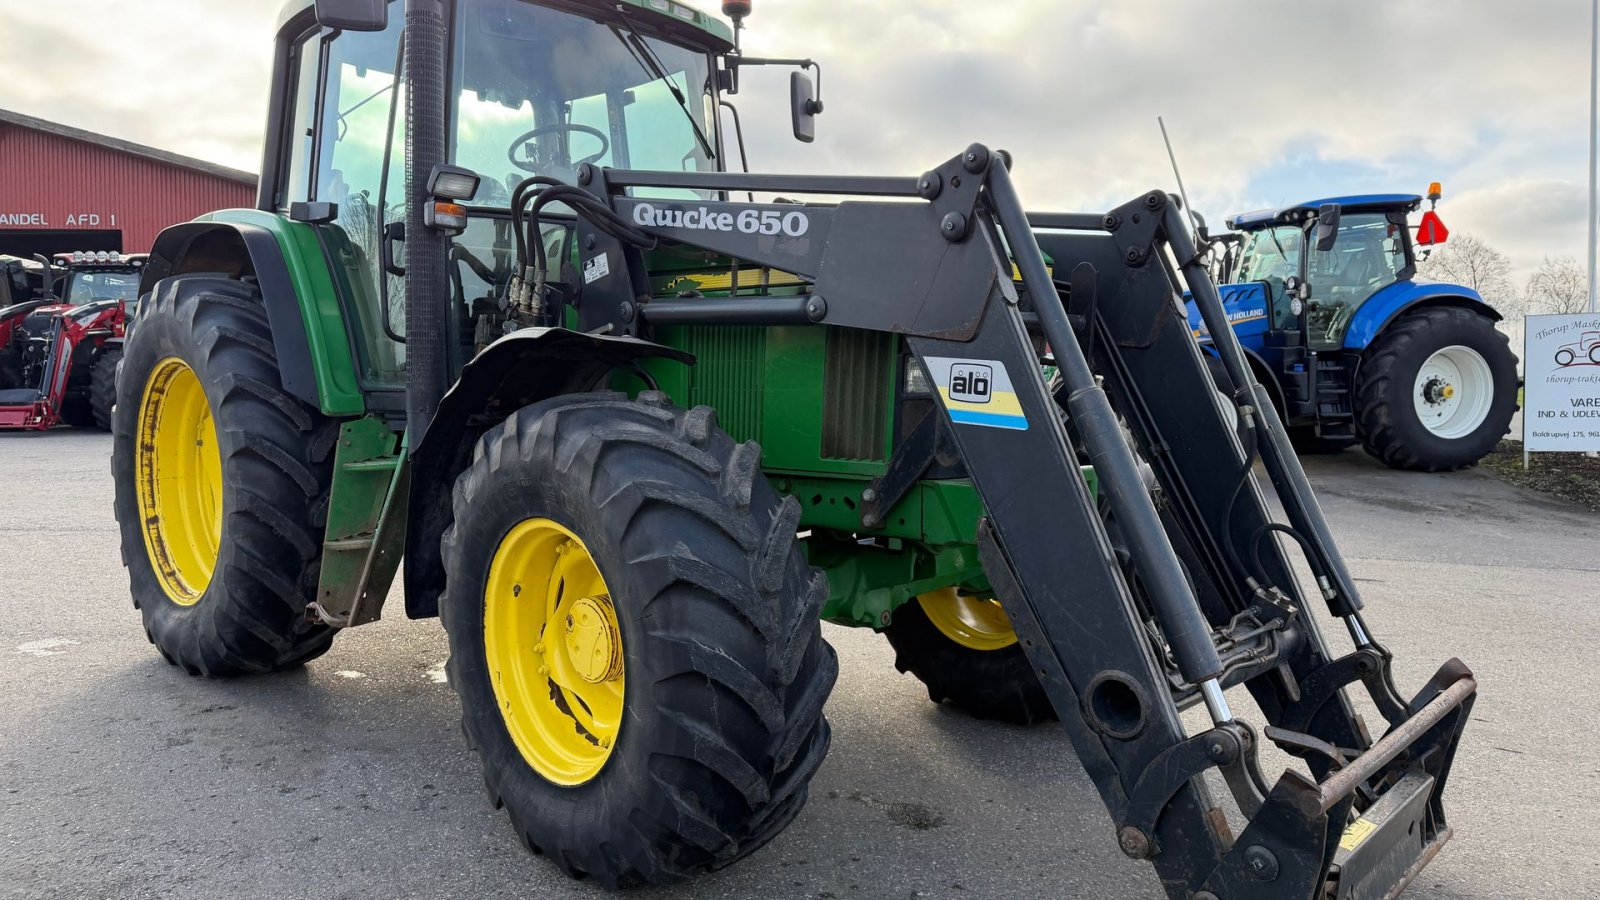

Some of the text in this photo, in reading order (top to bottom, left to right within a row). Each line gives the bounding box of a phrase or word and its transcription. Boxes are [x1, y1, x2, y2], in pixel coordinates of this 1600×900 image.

[66, 213, 100, 226] AFD
[110, 214, 116, 226] 1
[632, 203, 809, 237] Quicke 650
[1233, 308, 1264, 320] HOLLAND
[1535, 324, 1569, 340] Thorup
[1570, 397, 1600, 408] VARE
[1537, 410, 1556, 418] IND
[1559, 410, 1569, 418] &
[1532, 431, 1570, 439] Boldrupvej
